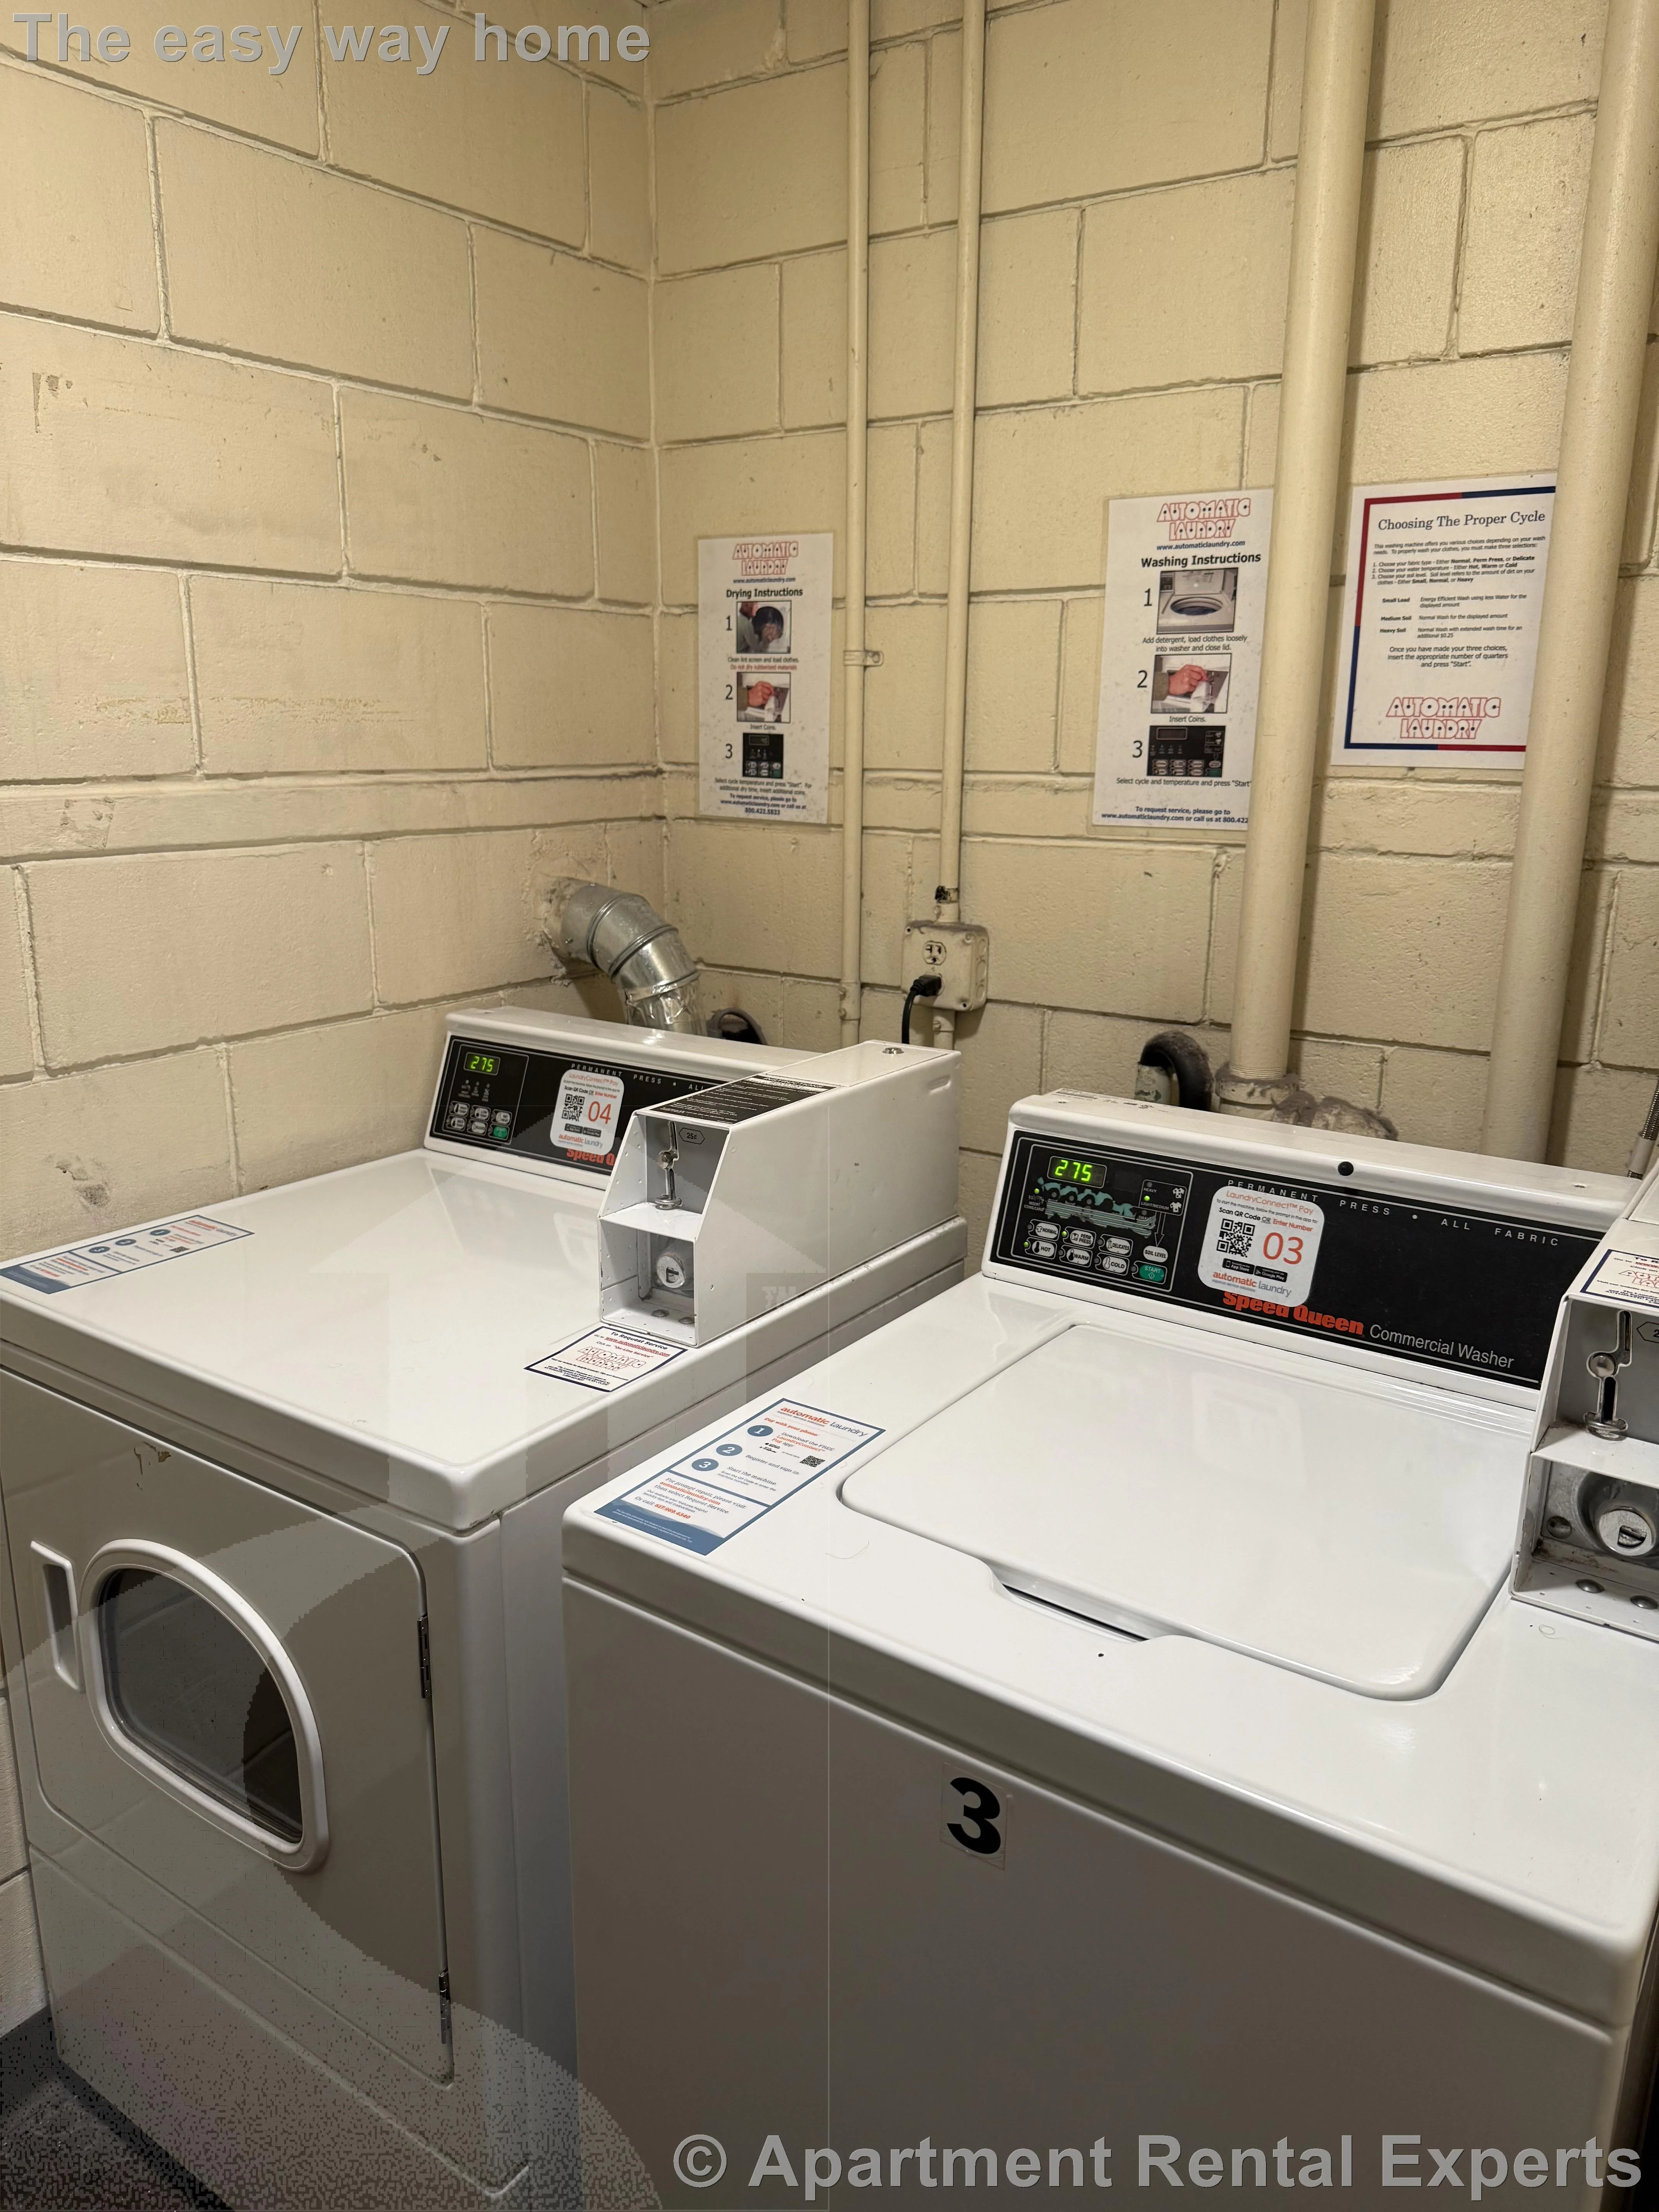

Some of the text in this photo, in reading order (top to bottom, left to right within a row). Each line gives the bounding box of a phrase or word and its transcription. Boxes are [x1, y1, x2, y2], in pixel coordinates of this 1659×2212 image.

[1157, 498, 1251, 522] AUTOMATIC
[1378, 511, 1545, 530] Choosing The Proper Cycle
[1169, 519, 1236, 541] LAUNDRY
[732, 541, 799, 560] AUTOMATIC
[1157, 541, 1245, 550] www.automaticlaundry.com
[741, 558, 789, 576] LAUNDRY
[1141, 553, 1261, 568] Washing Instructions
[726, 588, 803, 599] Drying Instructions
[1144, 588, 1152, 606] 1
[726, 615, 732, 631] 1
[1137, 670, 1147, 688] 2
[726, 685, 733, 700] 2
[1386, 697, 1501, 718] AUTOMATIC
[1400, 718, 1482, 739] LAUNDRY
[725, 744, 732, 758] 3
[1132, 740, 1142, 758] 3
[1101, 813, 1183, 821] www.automaticlaundry.com
[471, 1056, 494, 1072] 275
[571, 1063, 622, 1076] PERMANENT
[634, 1075, 662, 1084] PRESS
[588, 1101, 611, 1124] 04
[558, 1134, 584, 1143] automatic
[584, 1139, 603, 1148] laundry
[1055, 1160, 1092, 1182] 275
[1228, 1180, 1559, 1246] PERMANENT PRESS ALL FABRIC
[1299, 1205, 1313, 1215] Pay
[1289, 1223, 1313, 1231] Number
[1263, 1232, 1303, 1265] 03
[1213, 1271, 1257, 1287] automatic
[1259, 1281, 1291, 1297] laundry
[619, 1334, 644, 1343] Request
[644, 1341, 668, 1350] Service
[1293, 1305, 1364, 1335] Queen
[1370, 1324, 1454, 1356] Commercial
[1459, 1343, 1514, 1369] Washer
[576, 1354, 627, 1371] LAUNDRY
[578, 1346, 646, 1368] AUTOMATIC
[780, 1407, 830, 1424] automatic
[830, 1422, 867, 1437] laundry
[781, 1432, 809, 1443] Download
[745, 1455, 768, 1464] Register
[660, 1481, 721, 1505] automaticlaundry.com
[674, 1481, 696, 1491] prompt
[713, 1494, 732, 1503] please
[685, 1495, 708, 1506] Request
[947, 1777, 1001, 1854] 3
